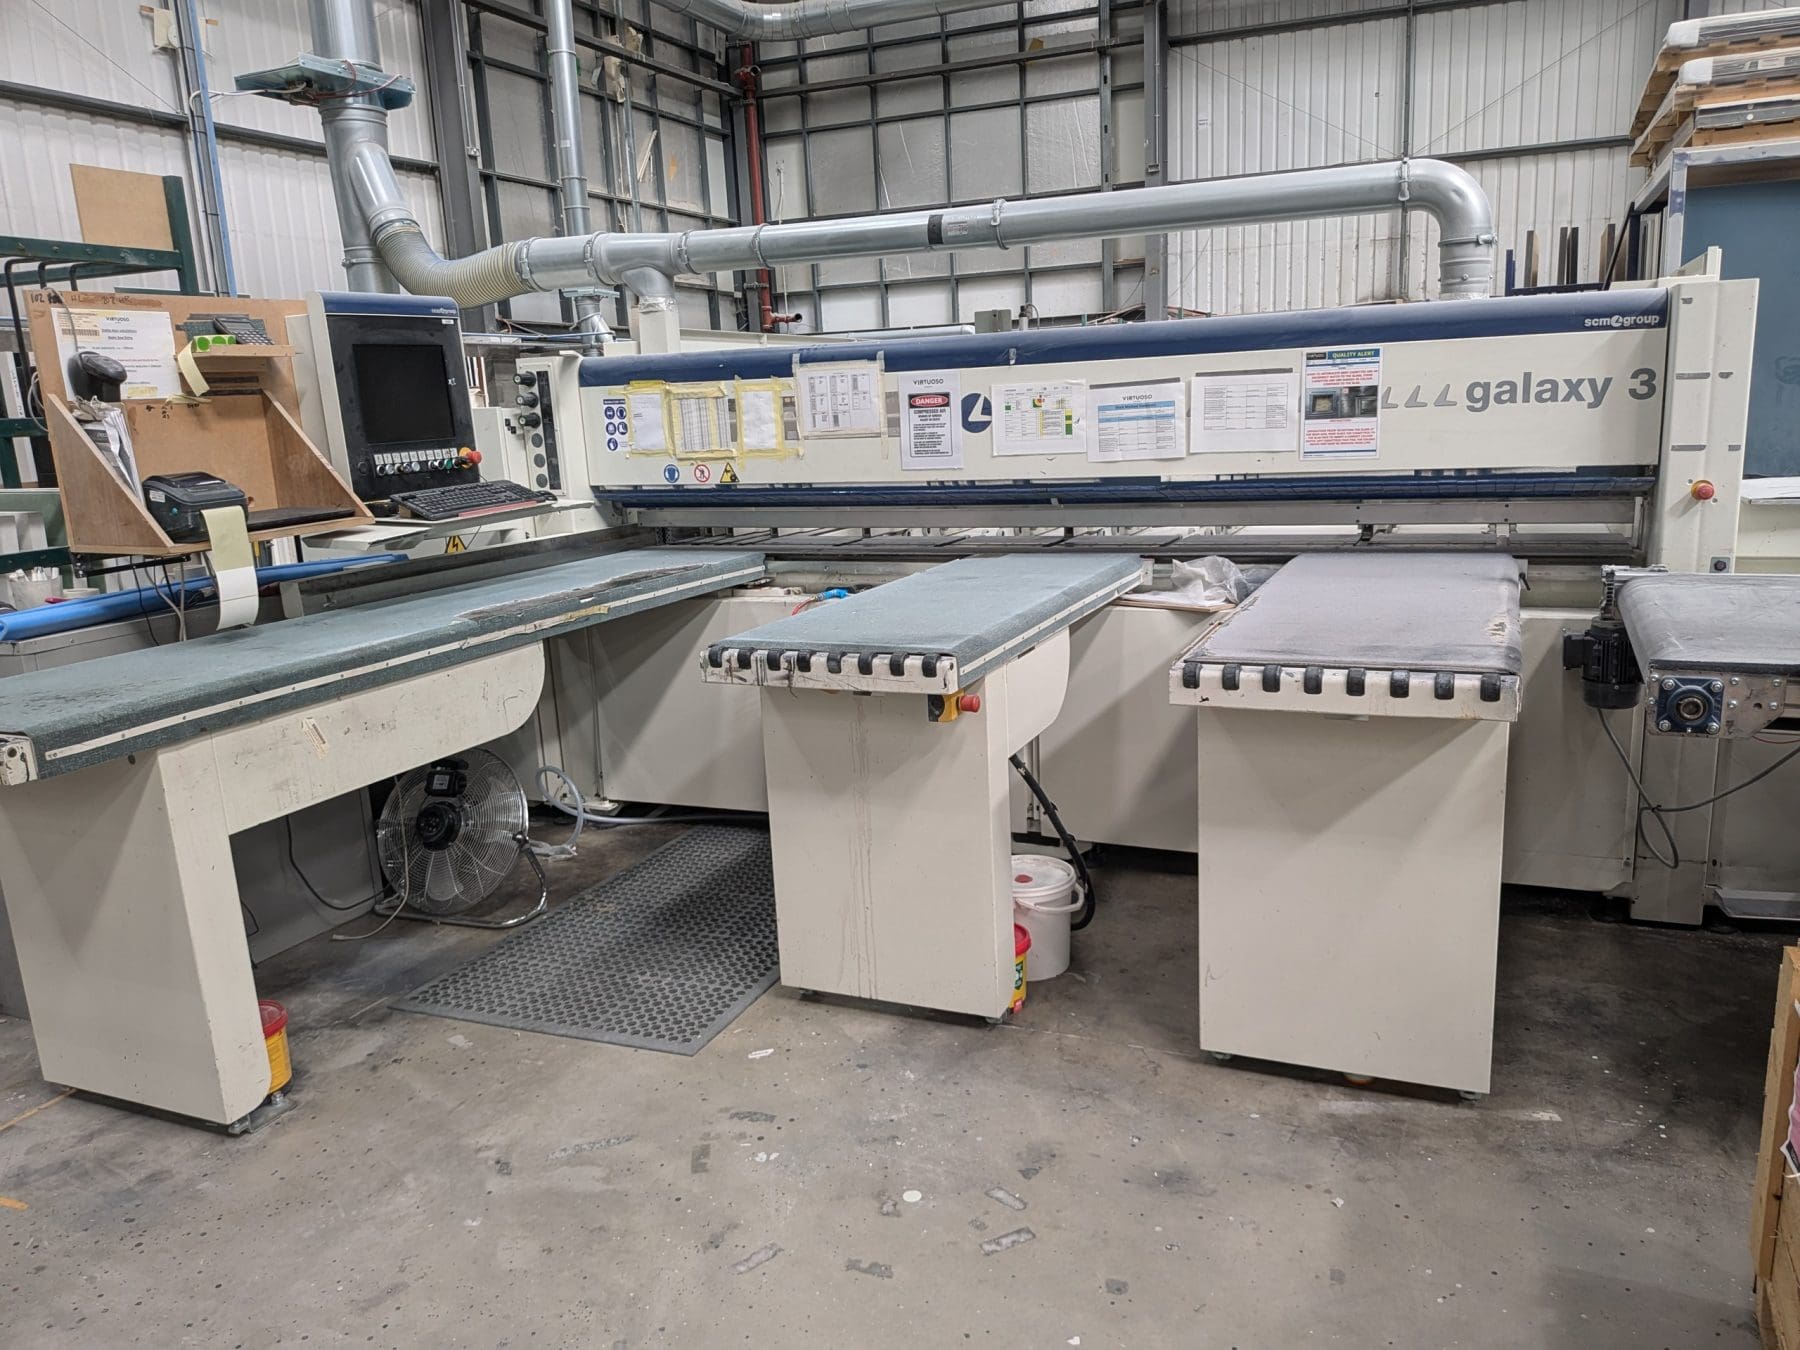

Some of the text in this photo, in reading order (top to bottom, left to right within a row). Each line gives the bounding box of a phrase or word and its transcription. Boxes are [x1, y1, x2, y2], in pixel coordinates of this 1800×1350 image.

[30, 294, 45, 304] 102
[1584, 314, 1660, 328] scm group
[1332, 351, 1357, 359] QUALITY
[1465, 367, 1657, 413] galaxy 3
[915, 397, 943, 405] DANGER
